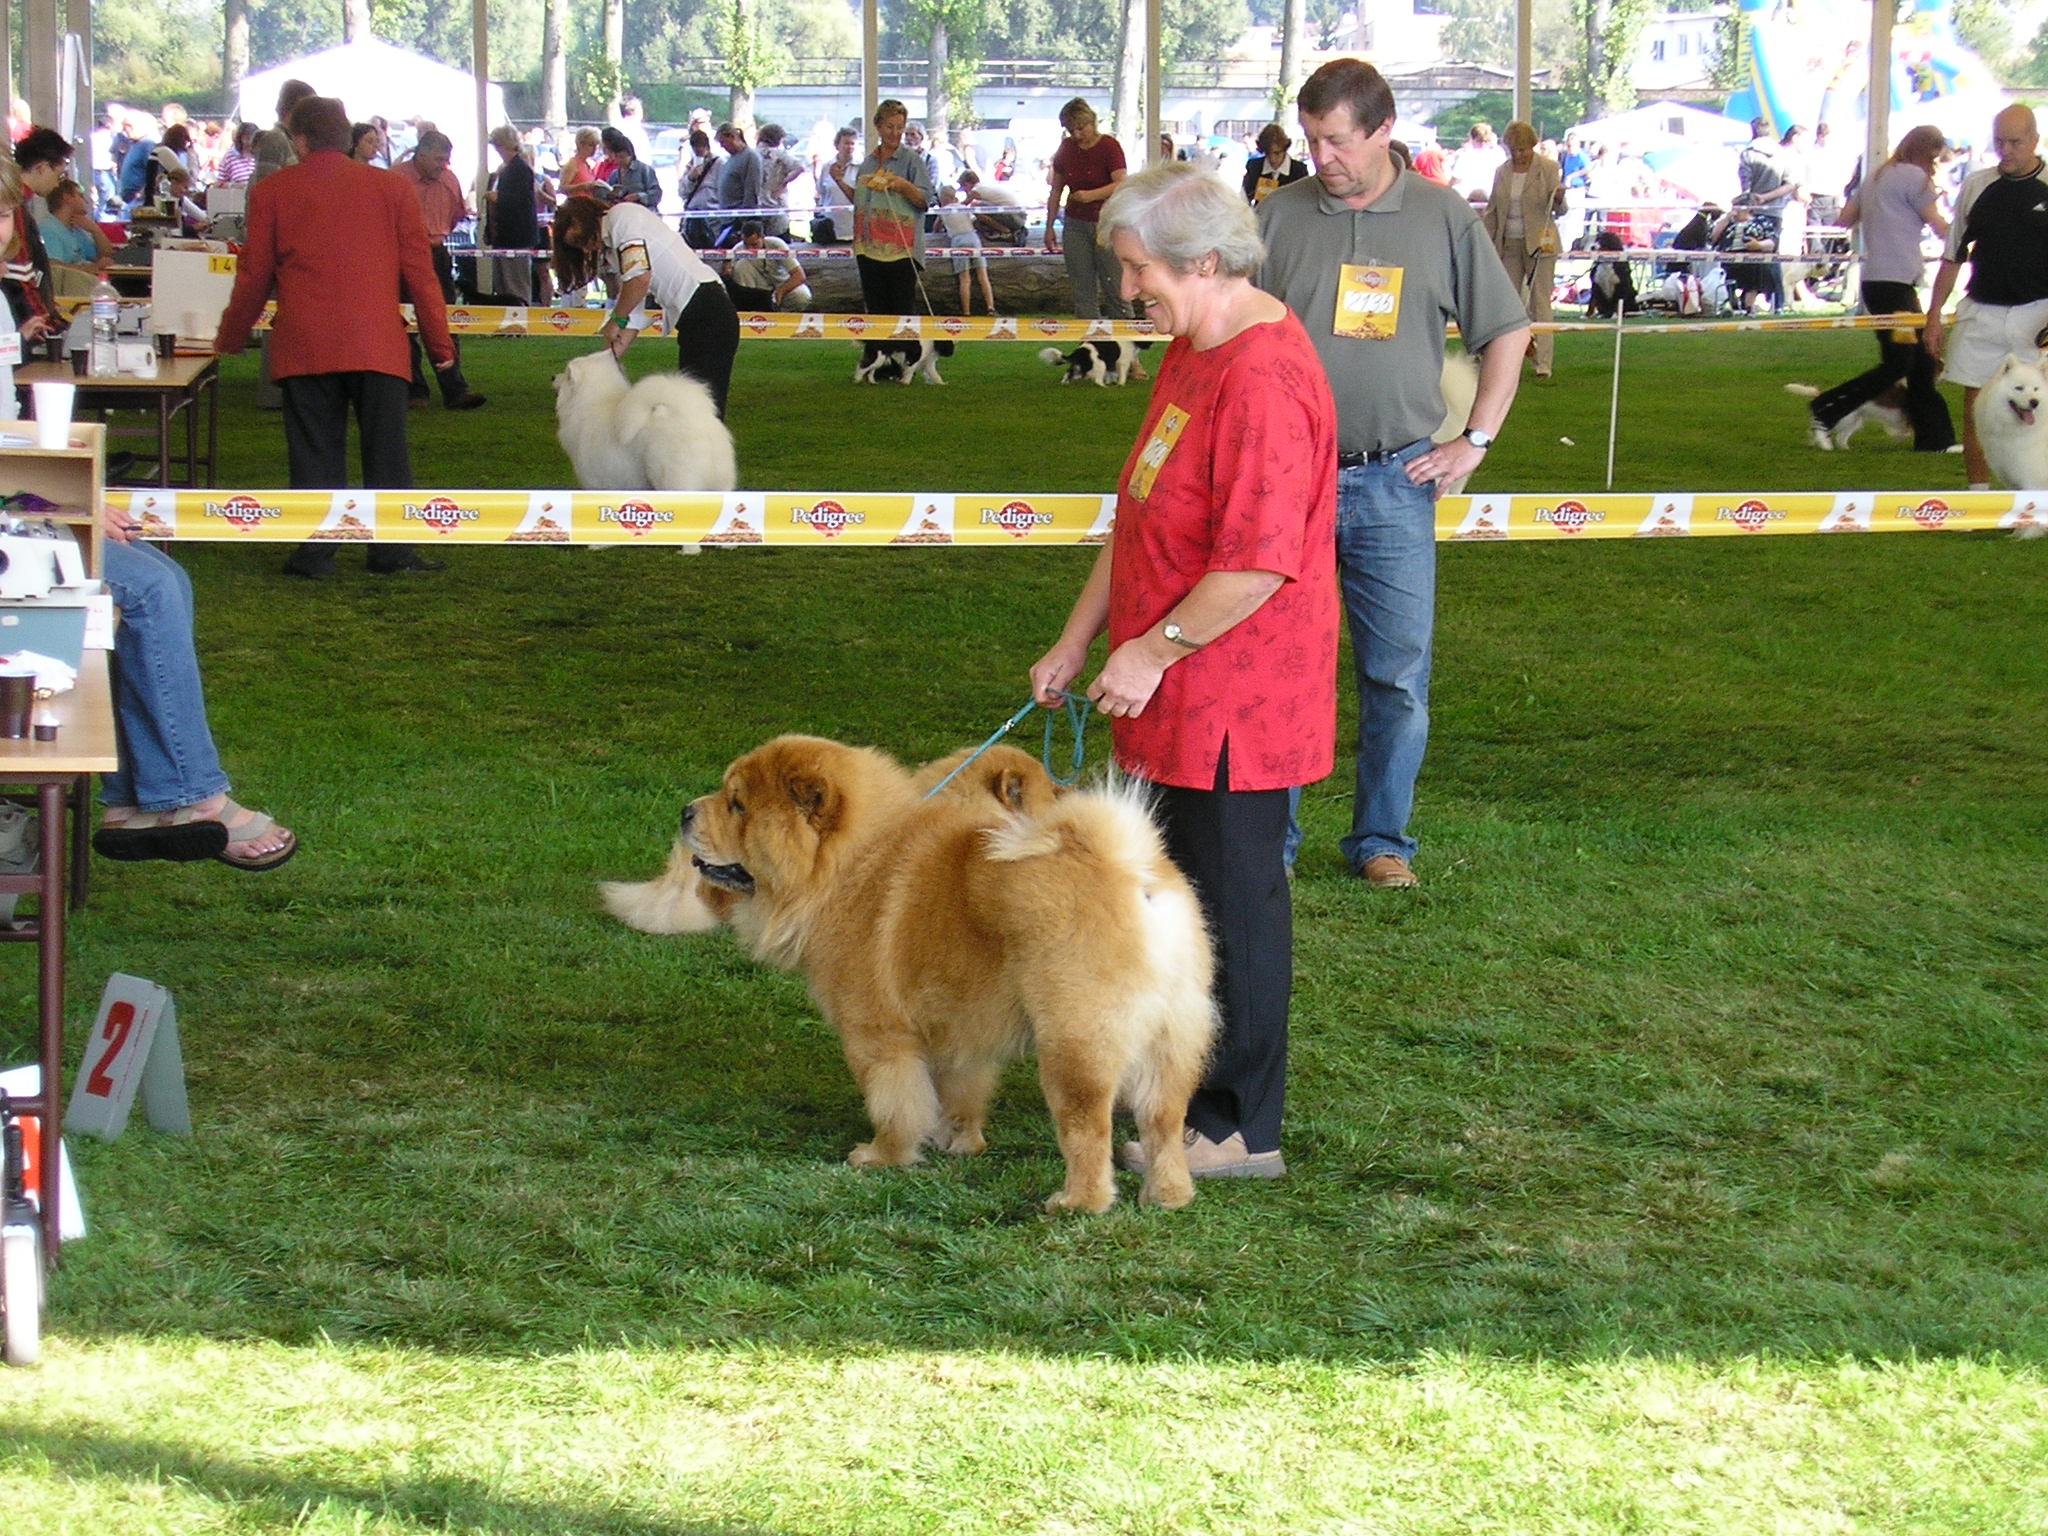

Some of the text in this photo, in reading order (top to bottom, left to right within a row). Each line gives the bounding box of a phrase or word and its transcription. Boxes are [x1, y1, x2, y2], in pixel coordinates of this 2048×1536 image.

[204, 501, 281, 521] Pedigree
[403, 504, 479, 525] Pedigree
[599, 506, 673, 527] Pedigree
[791, 506, 864, 528] Pedigree
[980, 509, 1053, 529] Pedigree
[1534, 508, 1604, 525] Pedigree
[1716, 506, 1786, 523] Pedigree
[1896, 505, 1966, 520] Pedigree
[86, 1000, 134, 1098] 2
